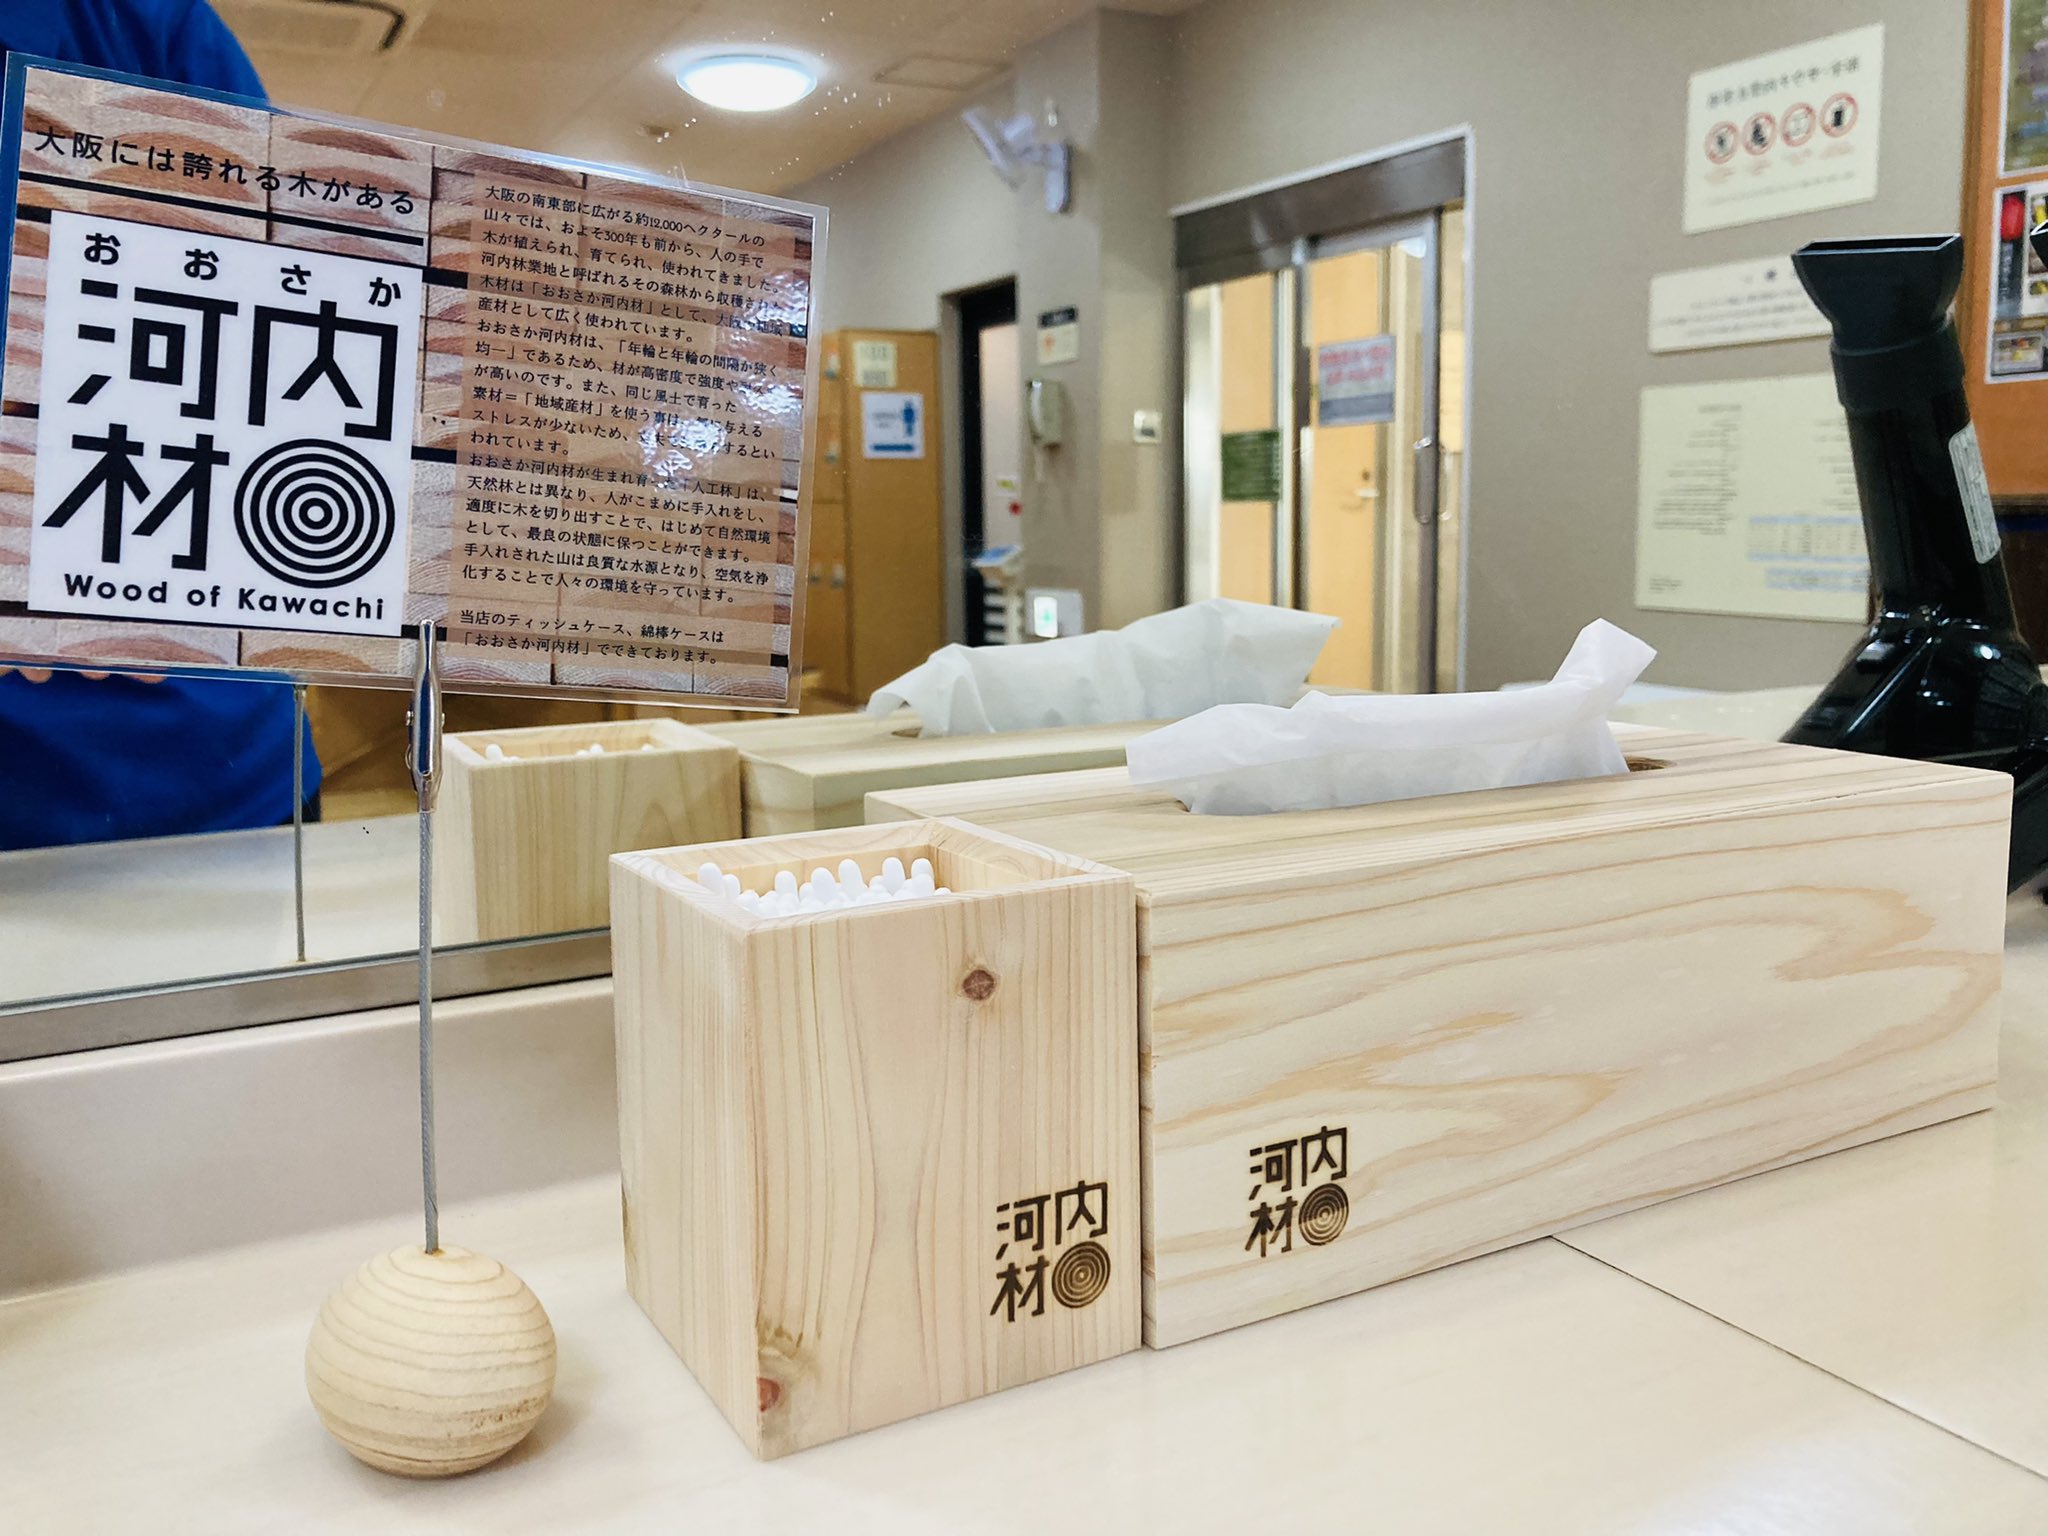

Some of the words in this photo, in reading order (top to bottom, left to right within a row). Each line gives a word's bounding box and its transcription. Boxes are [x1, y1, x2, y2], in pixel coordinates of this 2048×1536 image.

[35, 126, 415, 216] 大阪には誇れる木がある
[477, 296, 694, 343] 産材として広く使われています。
[473, 363, 737, 413] が高いのです。また、同じ風土で育った
[470, 431, 569, 456] われています。
[465, 497, 772, 545] 適度に木を切り出すことで、はじめて自然環境
[467, 475, 765, 523] 天然林とは異なり、人がこまめに手入れをし、
[463, 542, 770, 586] 手入れされた山は良質な水源となり、空気を浄
[466, 519, 750, 563] として、最良の状態に保つことができます。
[65, 573, 168, 604] Wood
[188, 586, 221, 608] of
[238, 588, 383, 620] Kawachi
[461, 564, 734, 603] 化することで人々の環境を守っています。
[460, 609, 724, 643] 当店のティッシュケース、綿棒ケースは
[463, 631, 718, 665] 「おおさか河内材」でできております。
[1248, 1126, 1348, 1200] 河内
[995, 1180, 1108, 1260] 河内
